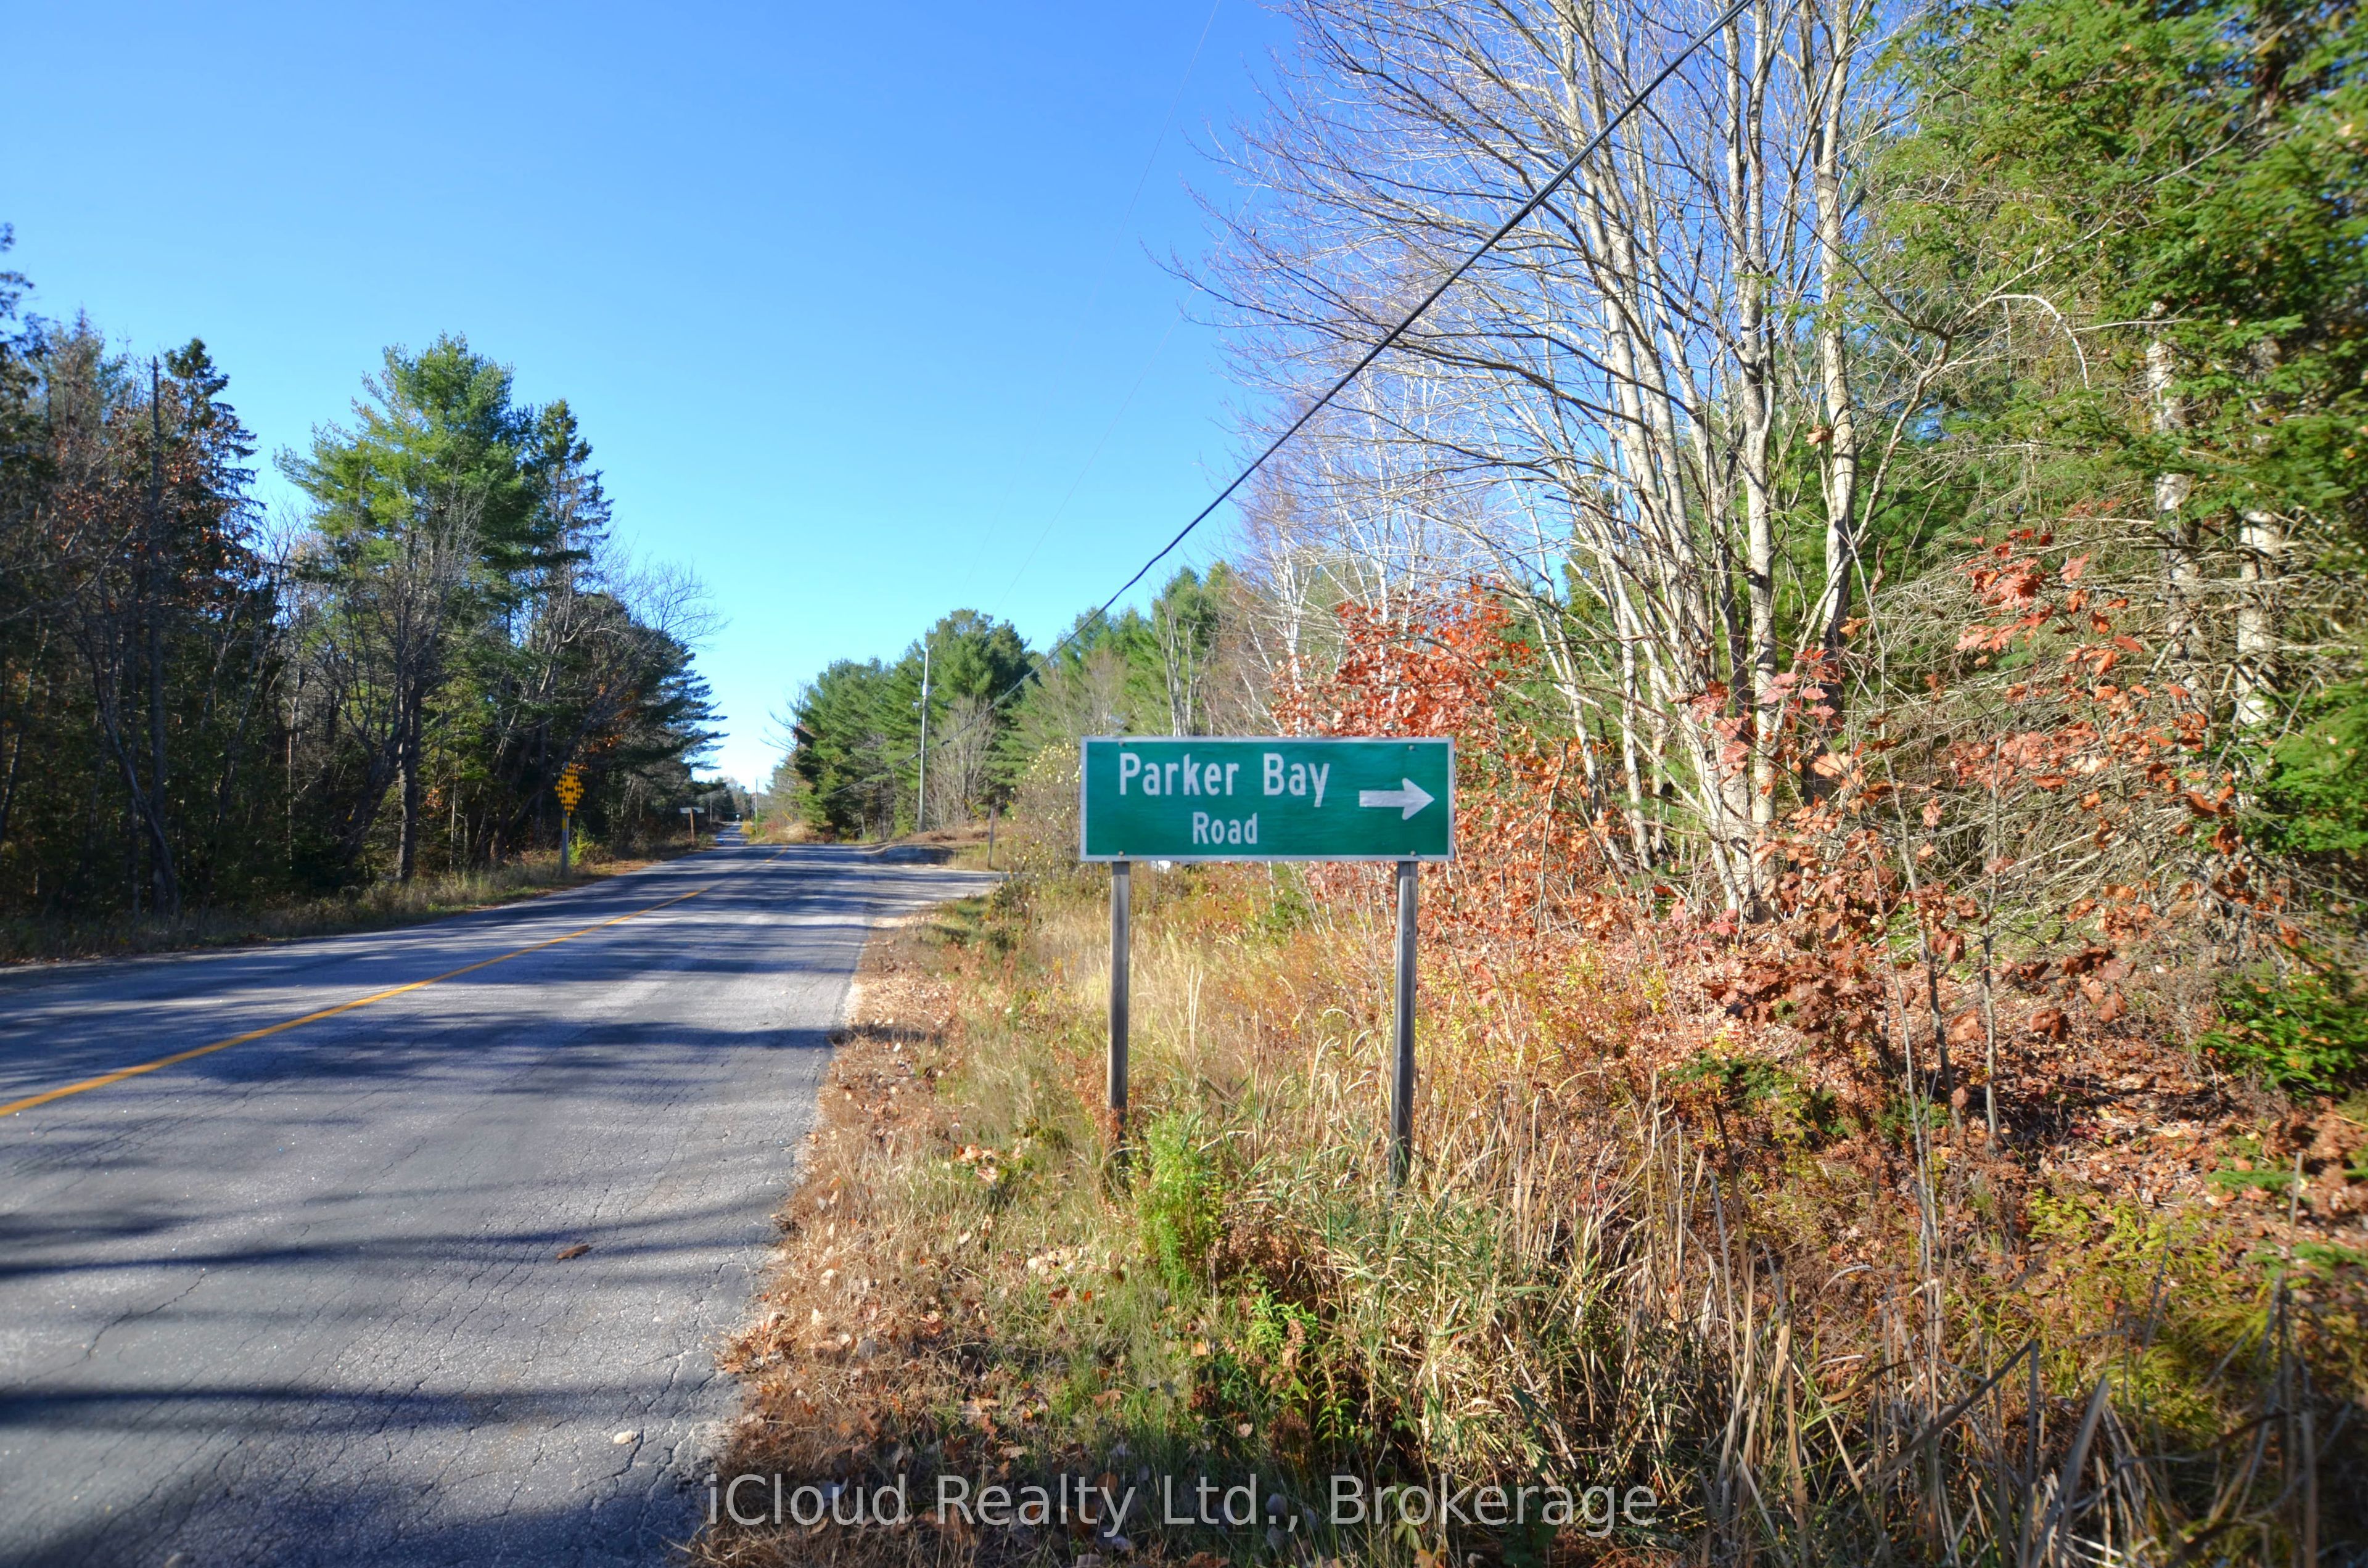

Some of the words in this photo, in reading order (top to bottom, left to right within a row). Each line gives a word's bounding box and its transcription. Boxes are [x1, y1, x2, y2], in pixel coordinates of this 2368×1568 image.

[1119, 752, 1240, 796] Parker
[1263, 752, 1330, 808] Bay
[1192, 811, 1258, 845] Road
